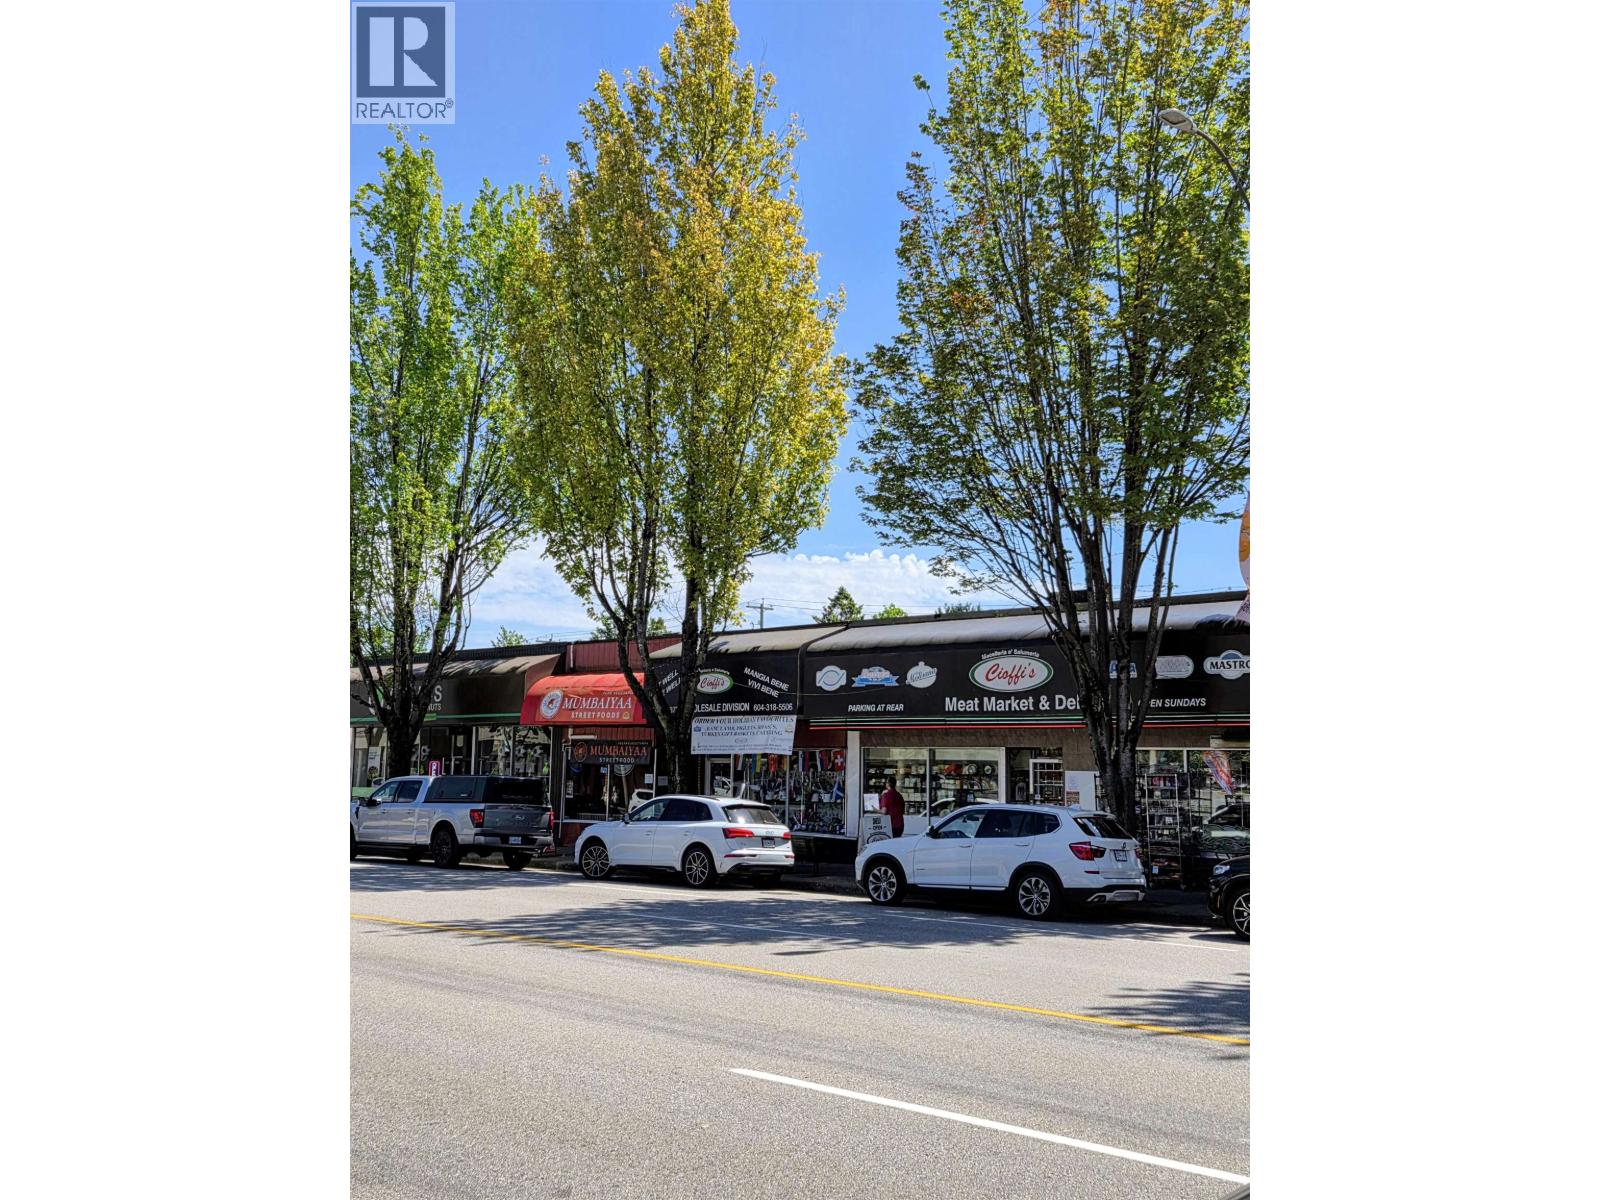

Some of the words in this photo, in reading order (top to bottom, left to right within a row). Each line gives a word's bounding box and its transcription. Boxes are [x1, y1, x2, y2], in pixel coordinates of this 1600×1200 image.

[744, 667, 772, 684] MANGIA
[770, 679, 790, 692] BENE
[985, 662, 1037, 686] Cioffi's
[748, 679, 761, 690] VIVI
[760, 686, 780, 698] BENE
[562, 697, 632, 710] MUMBAIYAA
[722, 702, 750, 712] DIVISION
[753, 703, 793, 712] 604-318-5506
[848, 703, 876, 713] PARKING
[877, 703, 886, 712] AT
[886, 703, 904, 712] REAR
[945, 696, 980, 712] Meat
[983, 695, 1034, 712] Market
[1039, 695, 1050, 710] &
[1164, 698, 1207, 708] SUNDAYS
[590, 745, 648, 756] MUMBAIYAA
